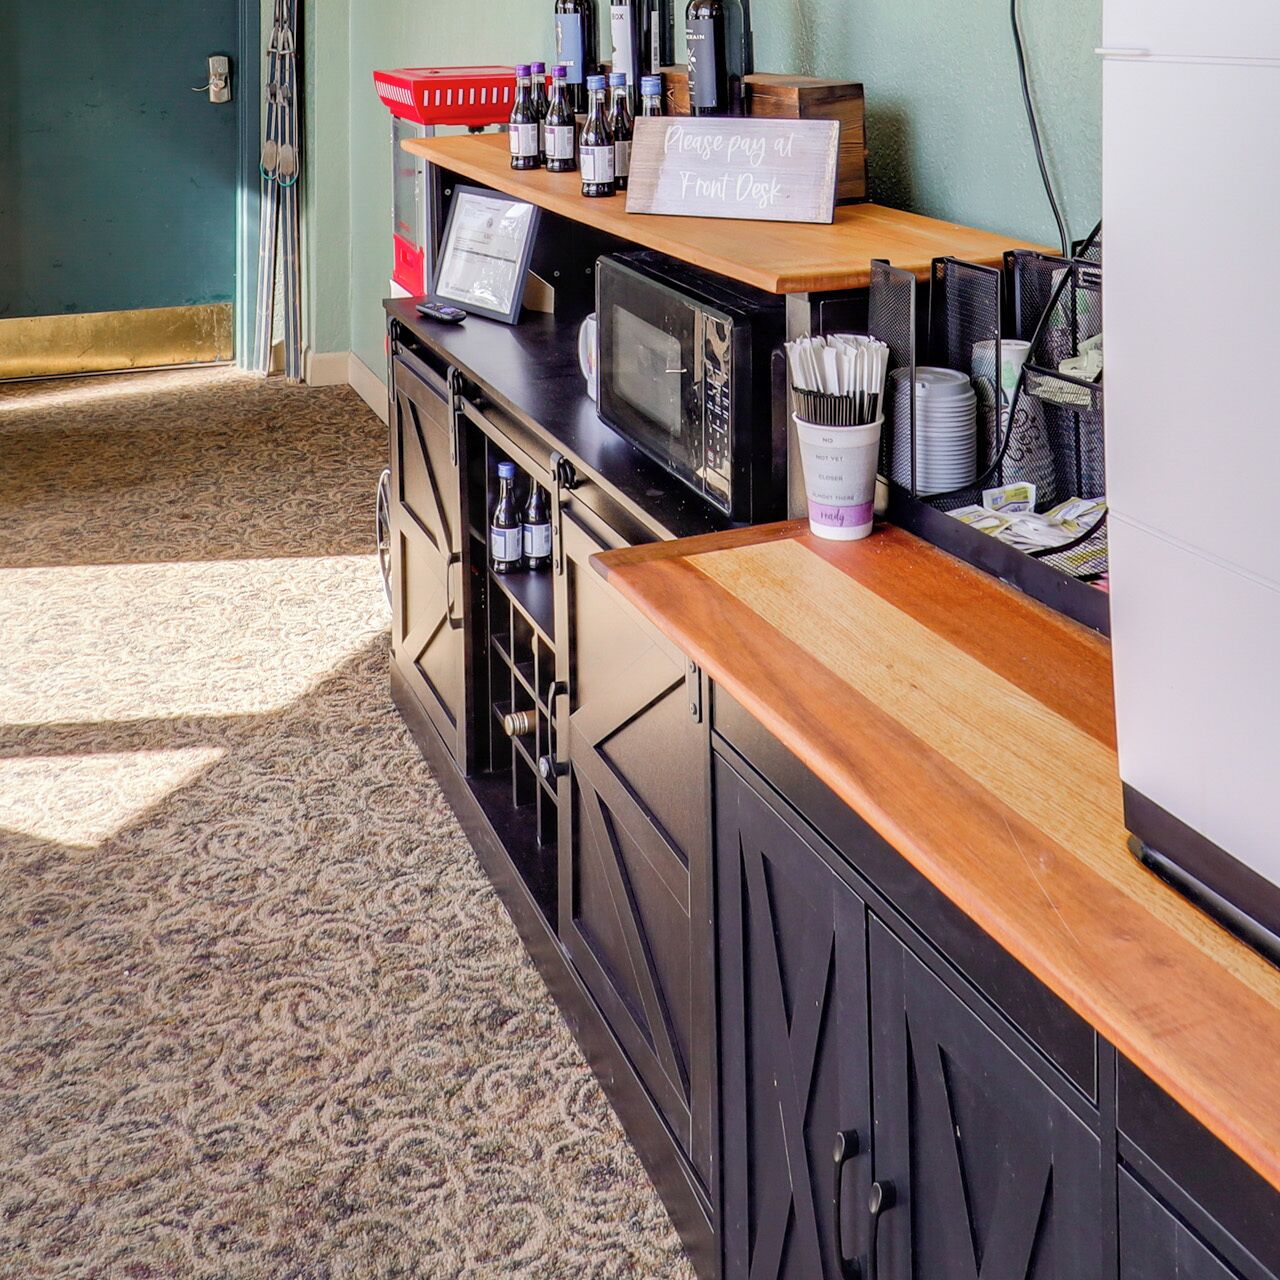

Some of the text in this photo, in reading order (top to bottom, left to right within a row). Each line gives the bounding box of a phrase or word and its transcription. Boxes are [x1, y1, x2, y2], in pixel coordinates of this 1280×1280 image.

[664, 125, 803, 166] Please pay at
[679, 171, 782, 209] Front Desk
[820, 508, 845, 527] ready
